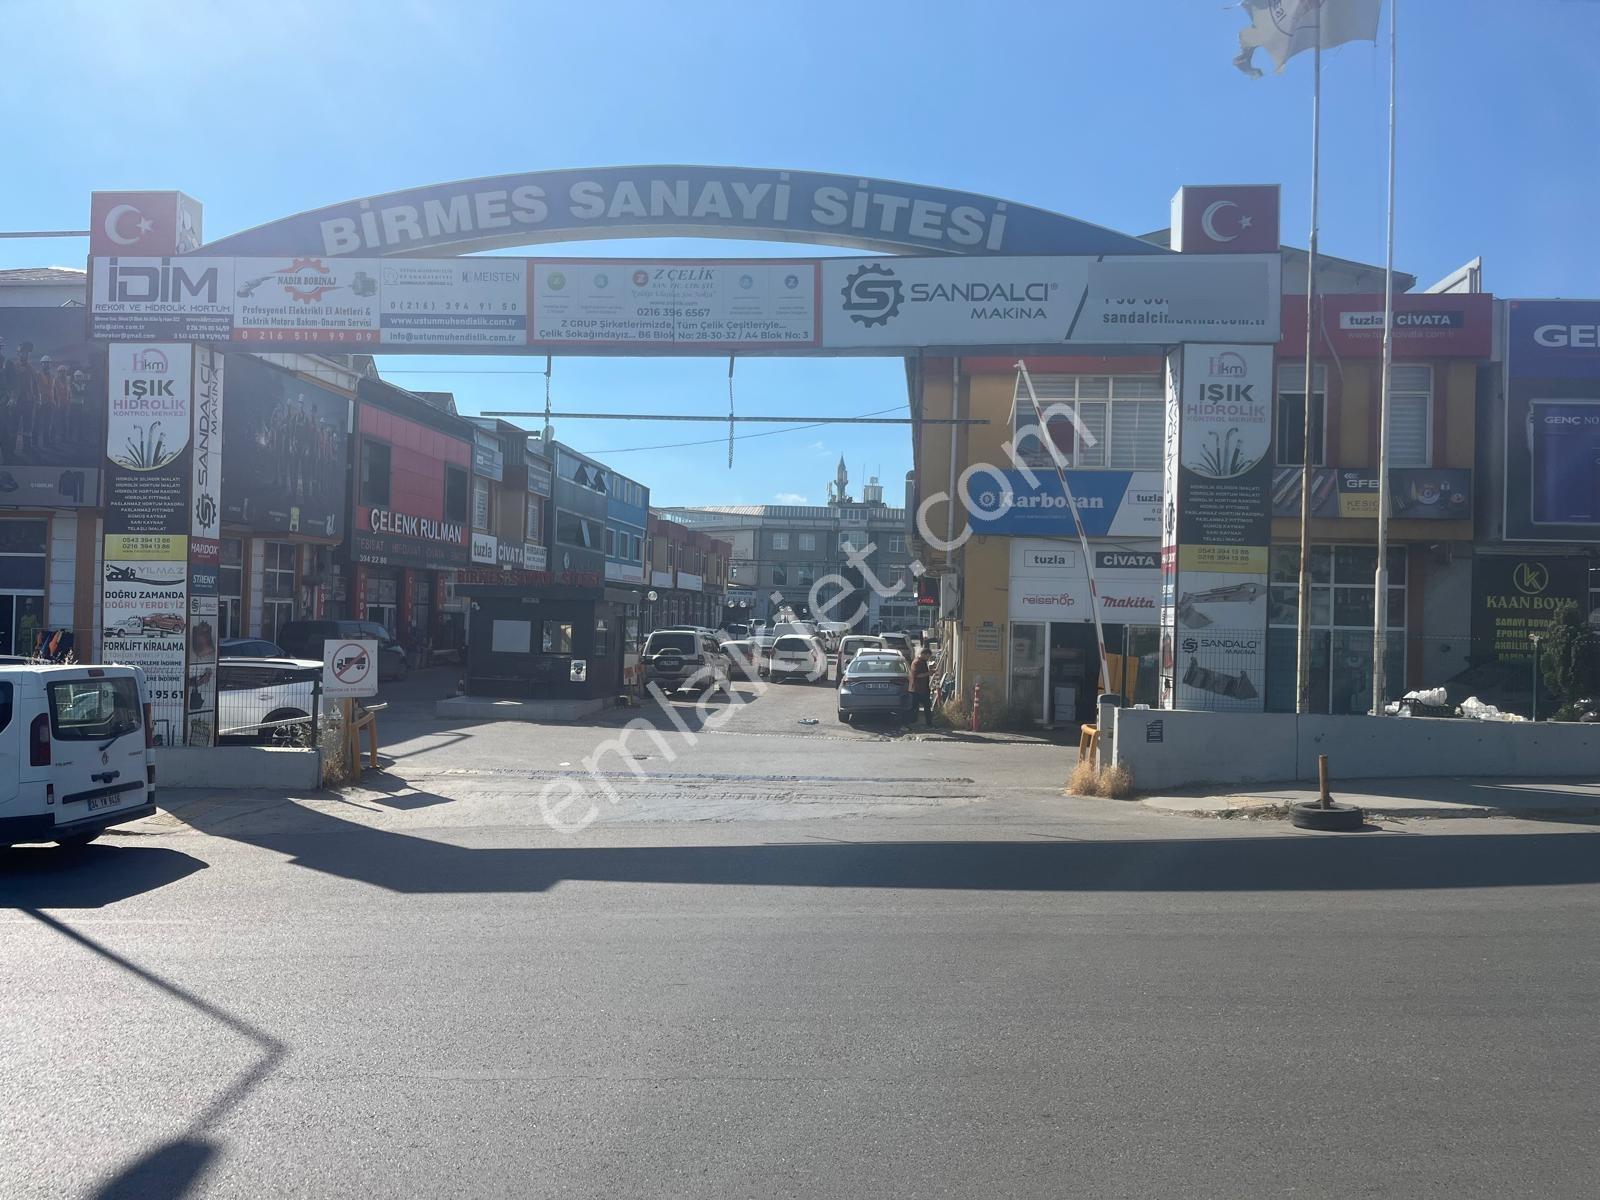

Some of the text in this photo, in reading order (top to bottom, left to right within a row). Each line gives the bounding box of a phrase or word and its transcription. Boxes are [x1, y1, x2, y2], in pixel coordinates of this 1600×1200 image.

[319, 172, 1008, 258] BİRMES SANAYİ SİTESİ
[108, 257, 218, 303] İDİM
[474, 272, 520, 282] MEISTEN
[652, 266, 714, 283] Z ÇELİK
[911, 283, 1048, 302] SANDALCI
[129, 304, 140, 312] VE
[190, 305, 231, 313] HORTUM
[242, 306, 287, 316] Profesyonel
[289, 306, 323, 315] Elektrikli
[334, 307, 363, 316] Aletleri
[365, 307, 371, 316] &
[479, 302, 492, 311] 91
[502, 302, 517, 311] 50
[637, 308, 711, 317] 0216 396 6567
[242, 317, 269, 325] Elektrik
[348, 318, 372, 327] Servisi
[561, 320, 567, 328] Z
[570, 320, 598, 328] GRUP
[599, 320, 675, 330] Şirketlerimizde,
[700, 321, 724, 330] Çelik
[1349, 313, 1451, 325] tuzla CİVATA
[242, 331, 248, 340] 0
[259, 332, 283, 340] 216
[539, 330, 563, 339] Çelik
[565, 330, 636, 339] Sokağındayız...
[638, 331, 651, 339] B6
[653, 331, 674, 339] Blok
[678, 331, 694, 339] No:
[696, 331, 736, 339] 28-30-32
[745, 331, 758, 339] A4
[761, 331, 782, 339] Blok
[785, 332, 801, 340] No:
[1533, 325, 1600, 348] GE
[124, 380, 175, 400] IŞIK
[1199, 384, 1254, 405] IŞIK
[113, 398, 185, 410] HİDROLİK
[1187, 404, 1265, 416] HİDROLİK
[198, 363, 211, 487] SANDALCI
[1544, 416, 1581, 425] GENÇ
[1137, 494, 1163, 502] tuzla
[371, 508, 462, 544] ÇELENK RULMAN
[473, 541, 493, 560] tuzla
[498, 541, 524, 564] CİVATA
[1033, 552, 1155, 566] tuzla CİVATA
[137, 566, 184, 575] YILMAZ
[105, 589, 185, 599] DOĞRU ZAMANDA
[105, 600, 137, 609] DOĞRU
[1487, 595, 1530, 608] KAAN
[104, 639, 184, 651] FORKLİFT KİRALAMA
[1201, 639, 1256, 648] SANDALCI
